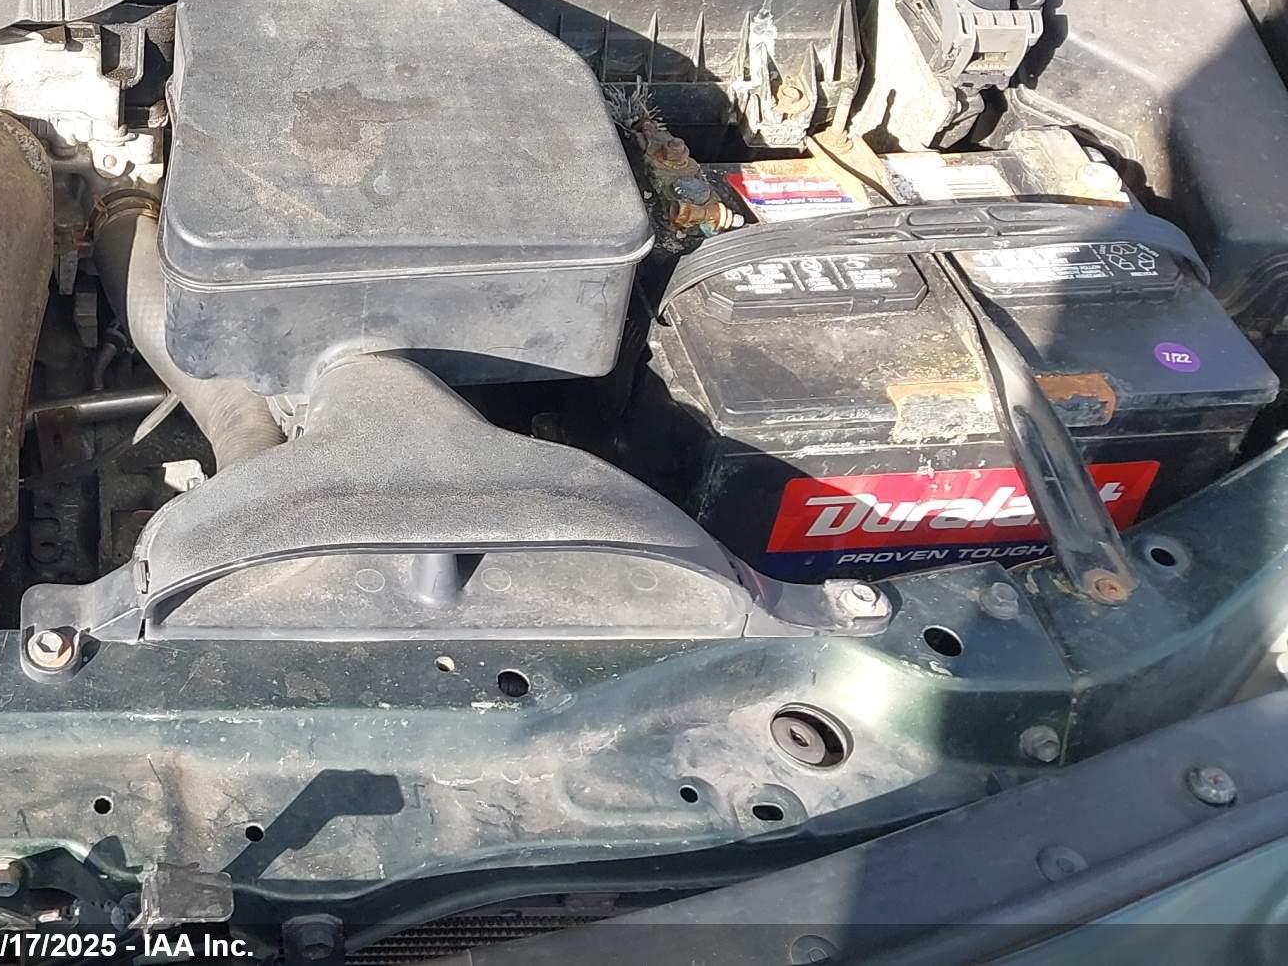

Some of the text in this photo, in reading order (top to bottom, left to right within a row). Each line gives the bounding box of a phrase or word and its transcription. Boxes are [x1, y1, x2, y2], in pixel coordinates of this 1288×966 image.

[805, 482, 1123, 537] Durala
[836, 544, 1049, 565] PROVEN TOUGH
